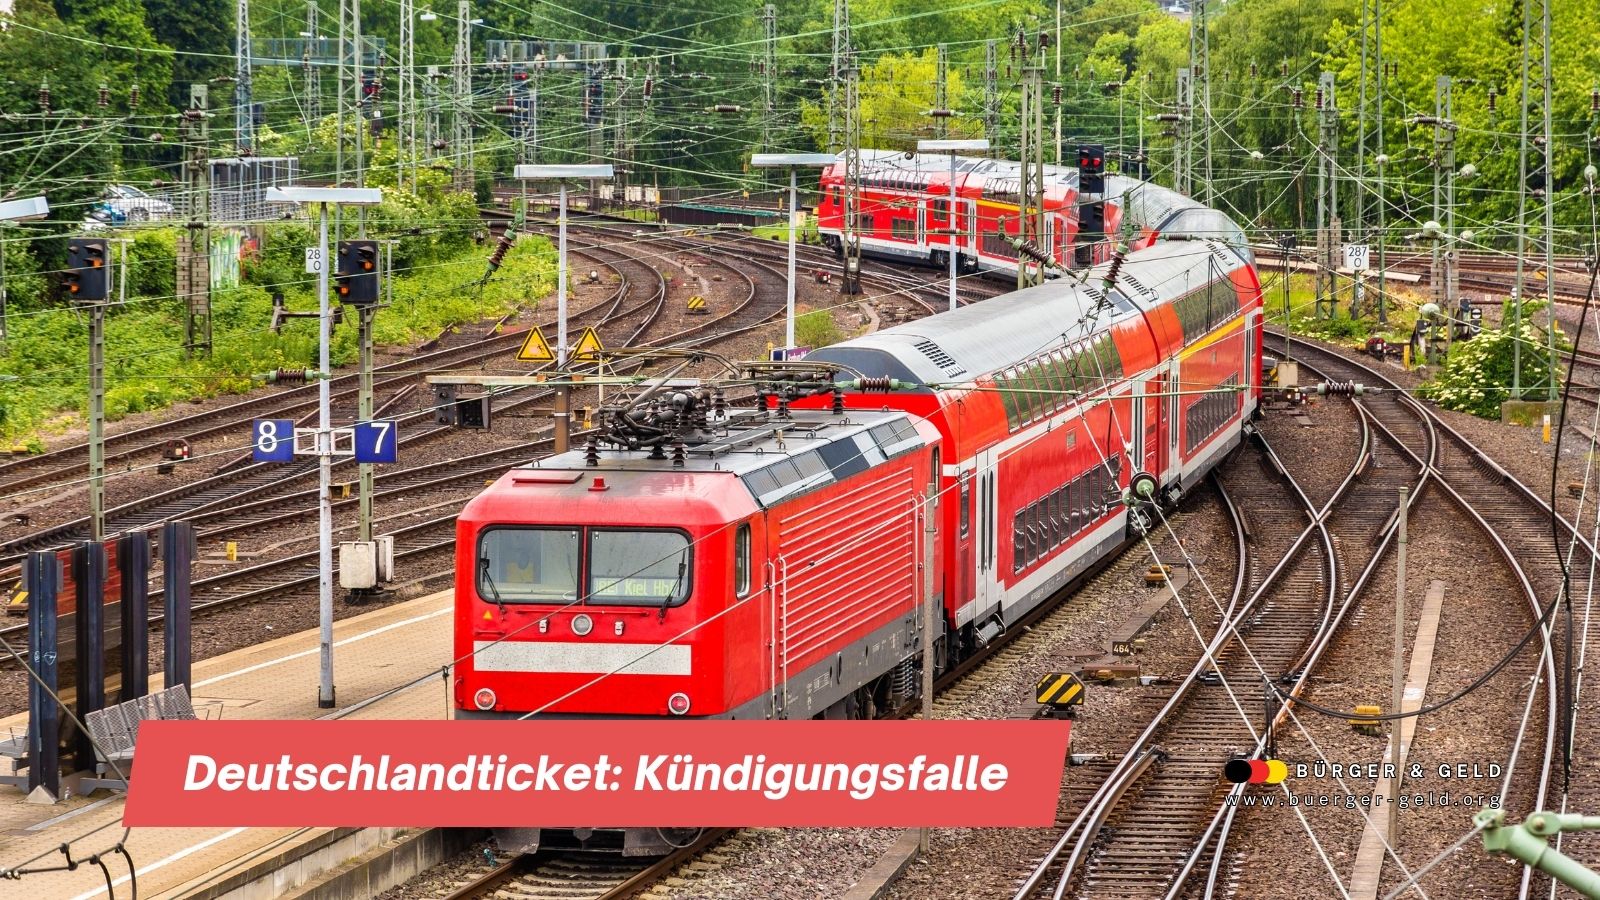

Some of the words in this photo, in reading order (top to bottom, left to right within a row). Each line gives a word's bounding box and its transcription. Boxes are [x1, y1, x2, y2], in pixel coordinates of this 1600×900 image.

[1348, 246, 1367, 257] 287
[313, 260, 321, 271] 0
[1354, 257, 1362, 268] 0
[258, 420, 278, 453] 8
[370, 422, 390, 454] 7
[625, 579, 647, 595] Kiel
[1113, 644, 1130, 654] 464
